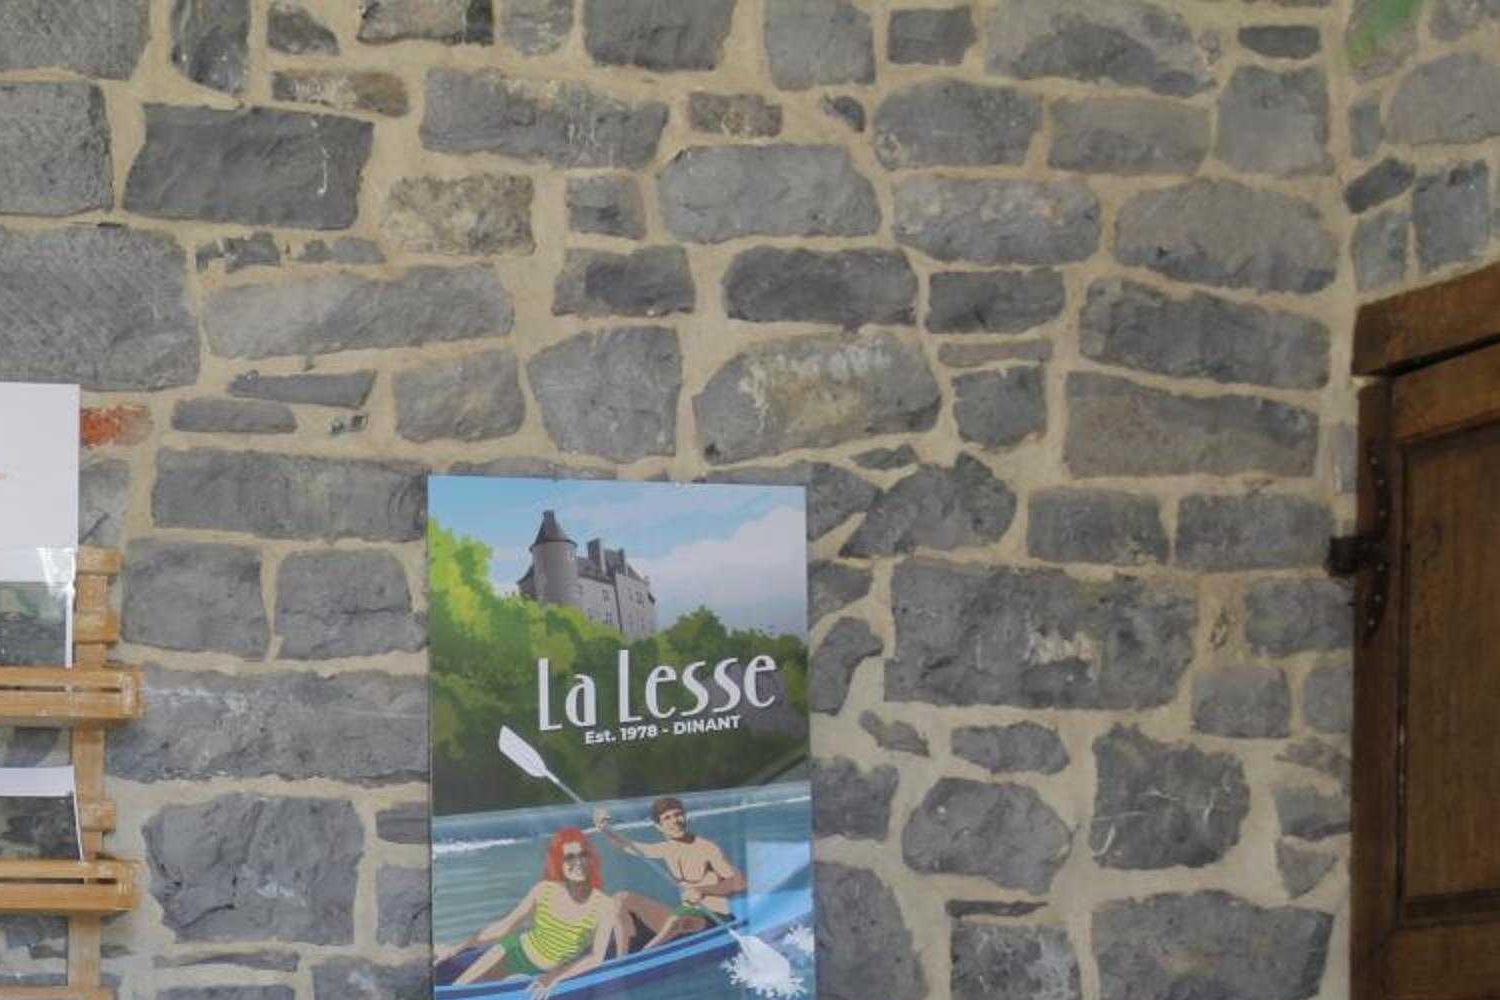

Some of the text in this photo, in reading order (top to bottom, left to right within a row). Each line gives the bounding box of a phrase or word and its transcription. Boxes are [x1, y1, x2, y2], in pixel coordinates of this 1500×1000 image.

[538, 649, 777, 731] La Lesse
[584, 730, 617, 745] Est.
[619, 724, 658, 740] 1978
[673, 715, 741, 735] DINANT
